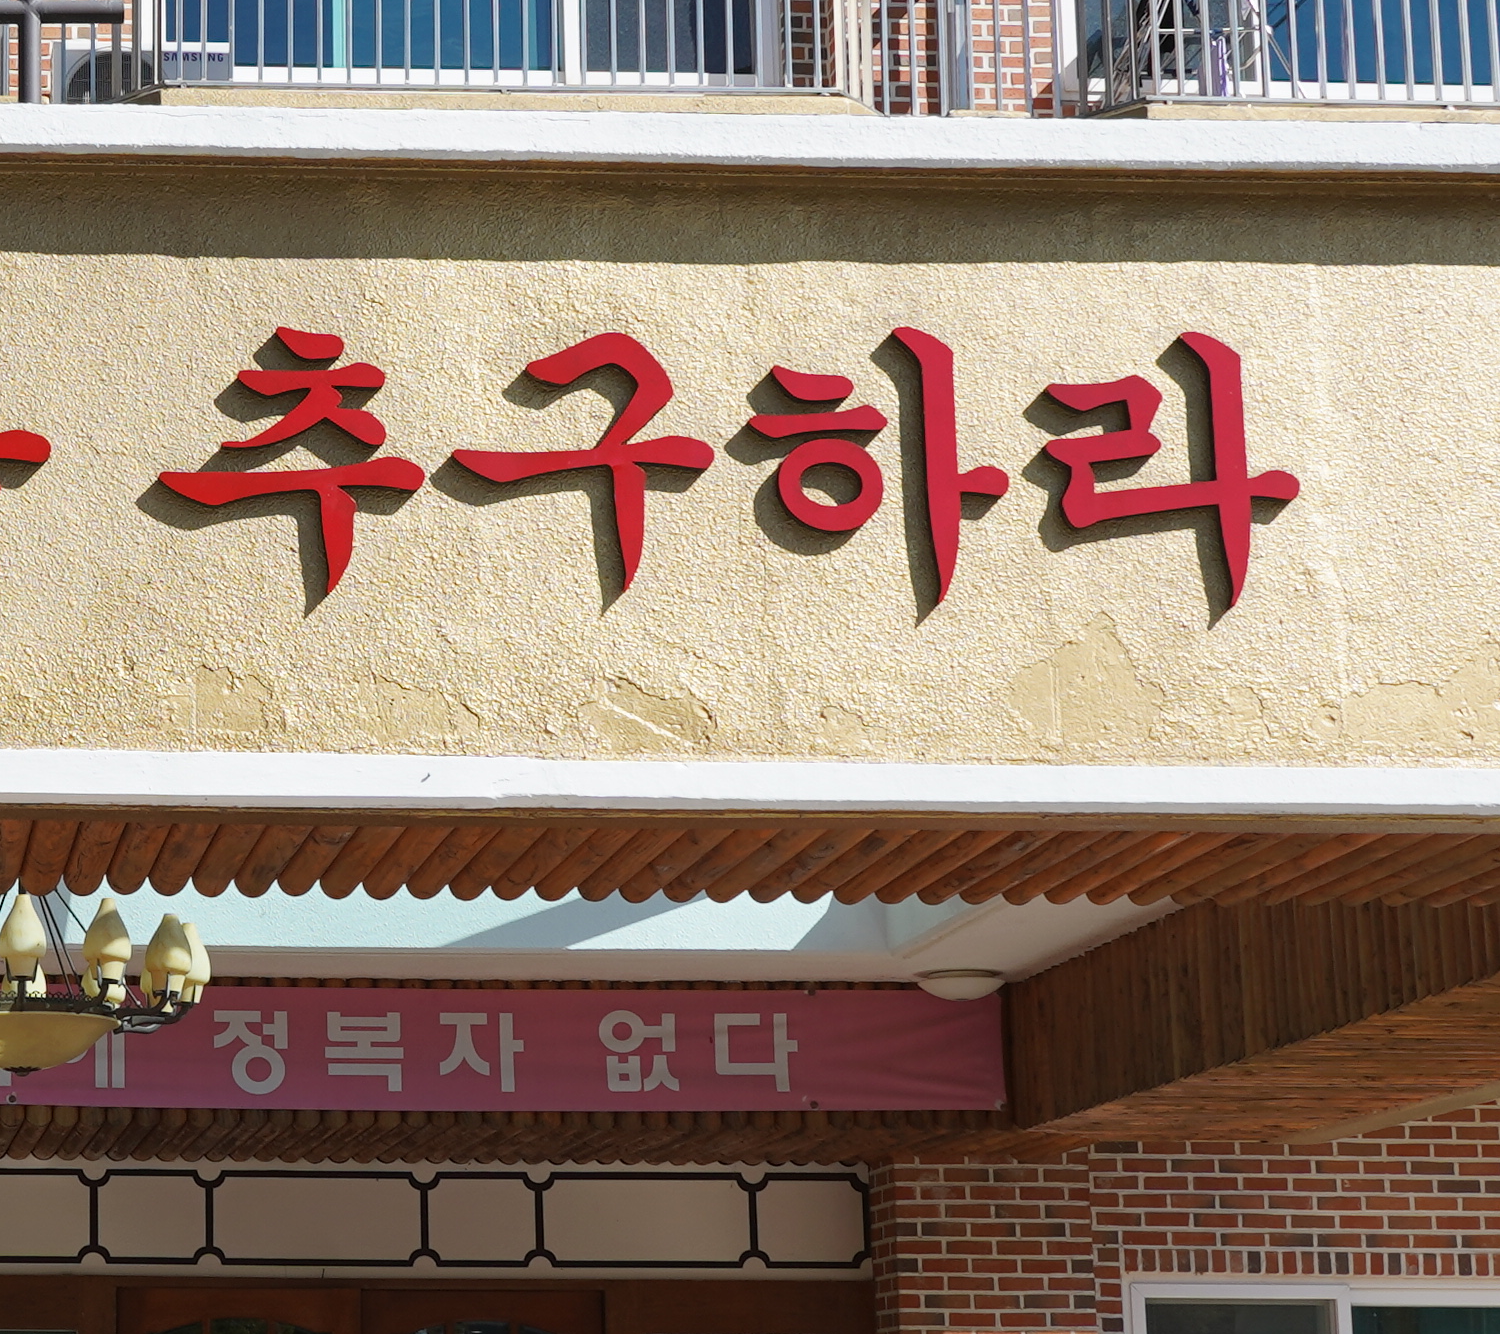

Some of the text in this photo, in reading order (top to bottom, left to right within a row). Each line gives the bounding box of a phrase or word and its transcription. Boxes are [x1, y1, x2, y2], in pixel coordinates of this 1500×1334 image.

[163, 52, 224, 62] SAMSNG
[159, 327, 1299, 606] 추구하라
[212, 1009, 525, 1095] 정복자
[598, 1008, 799, 1094] 없다
